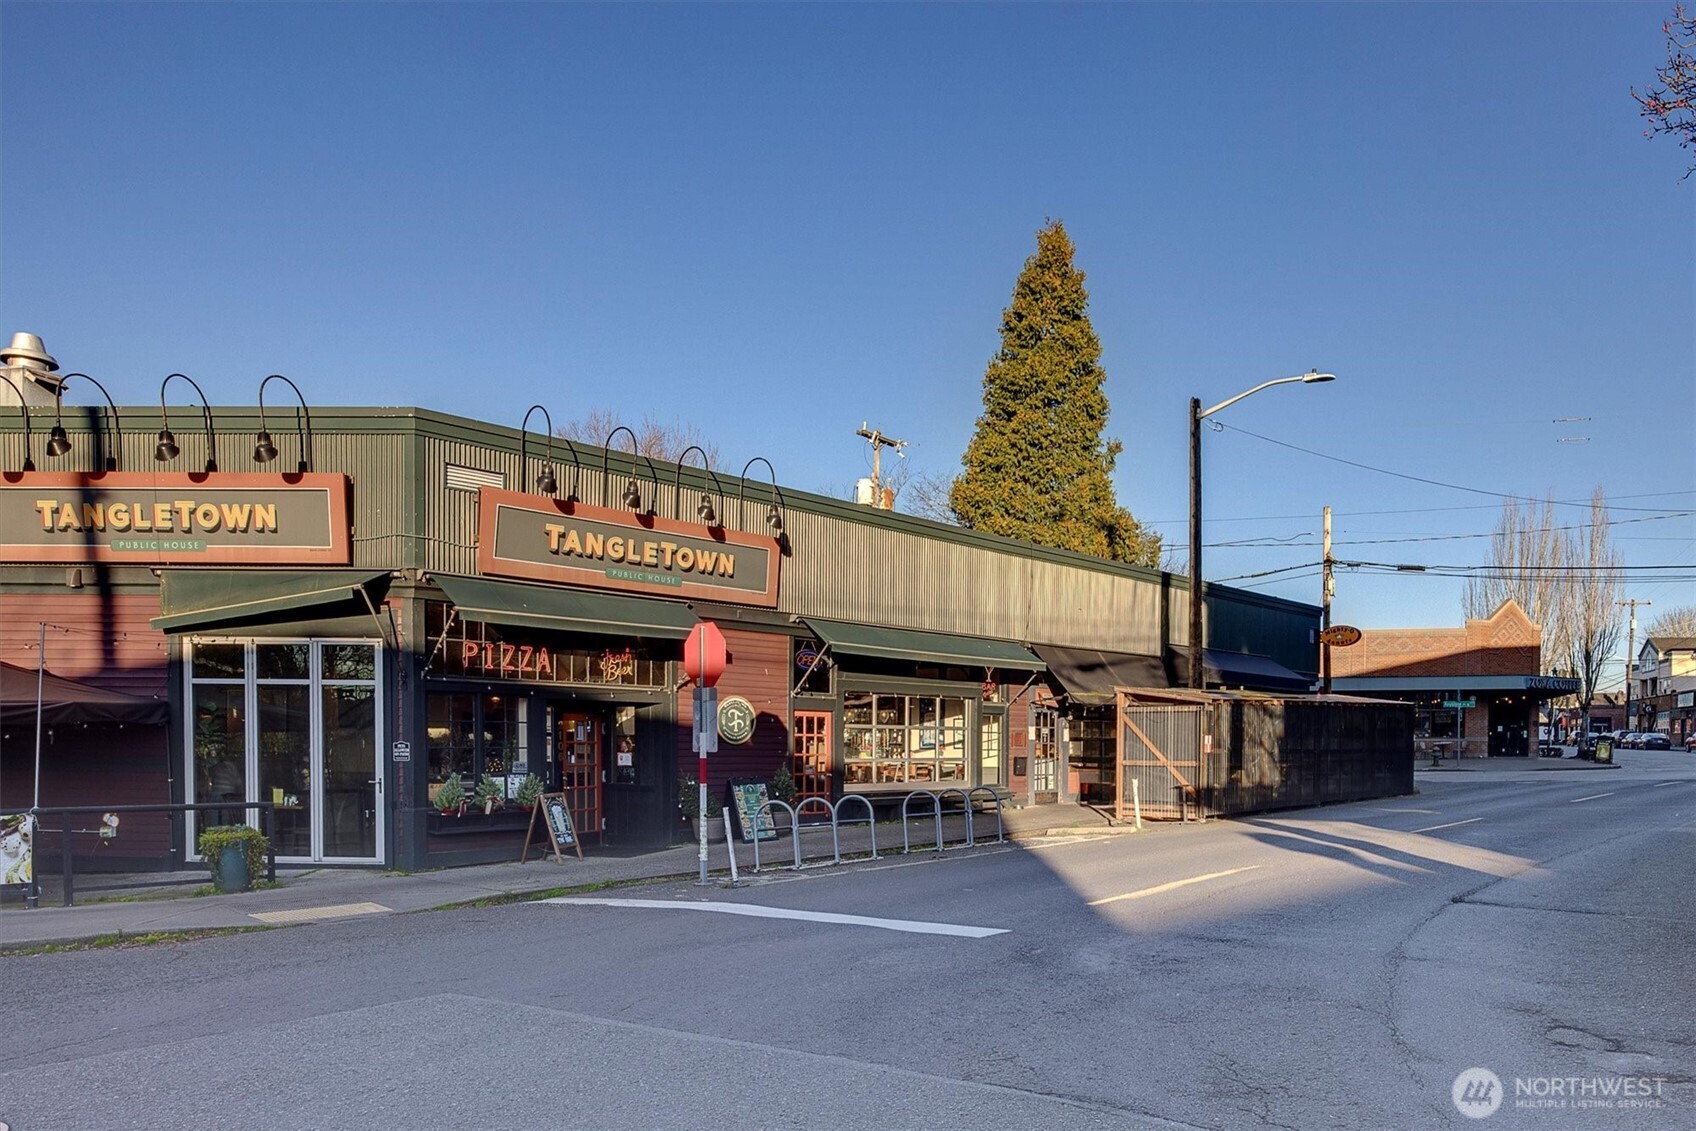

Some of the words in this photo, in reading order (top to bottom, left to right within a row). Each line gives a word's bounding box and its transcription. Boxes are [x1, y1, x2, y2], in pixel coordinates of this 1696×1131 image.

[36, 500, 278, 533] TANGLETOWN
[119, 541, 157, 549] PUBLIC
[545, 523, 735, 578] TANGLETOWN
[612, 570, 642, 581] PUBLIC
[648, 574, 676, 584] HOUSE
[463, 641, 551, 673] PIZZA
